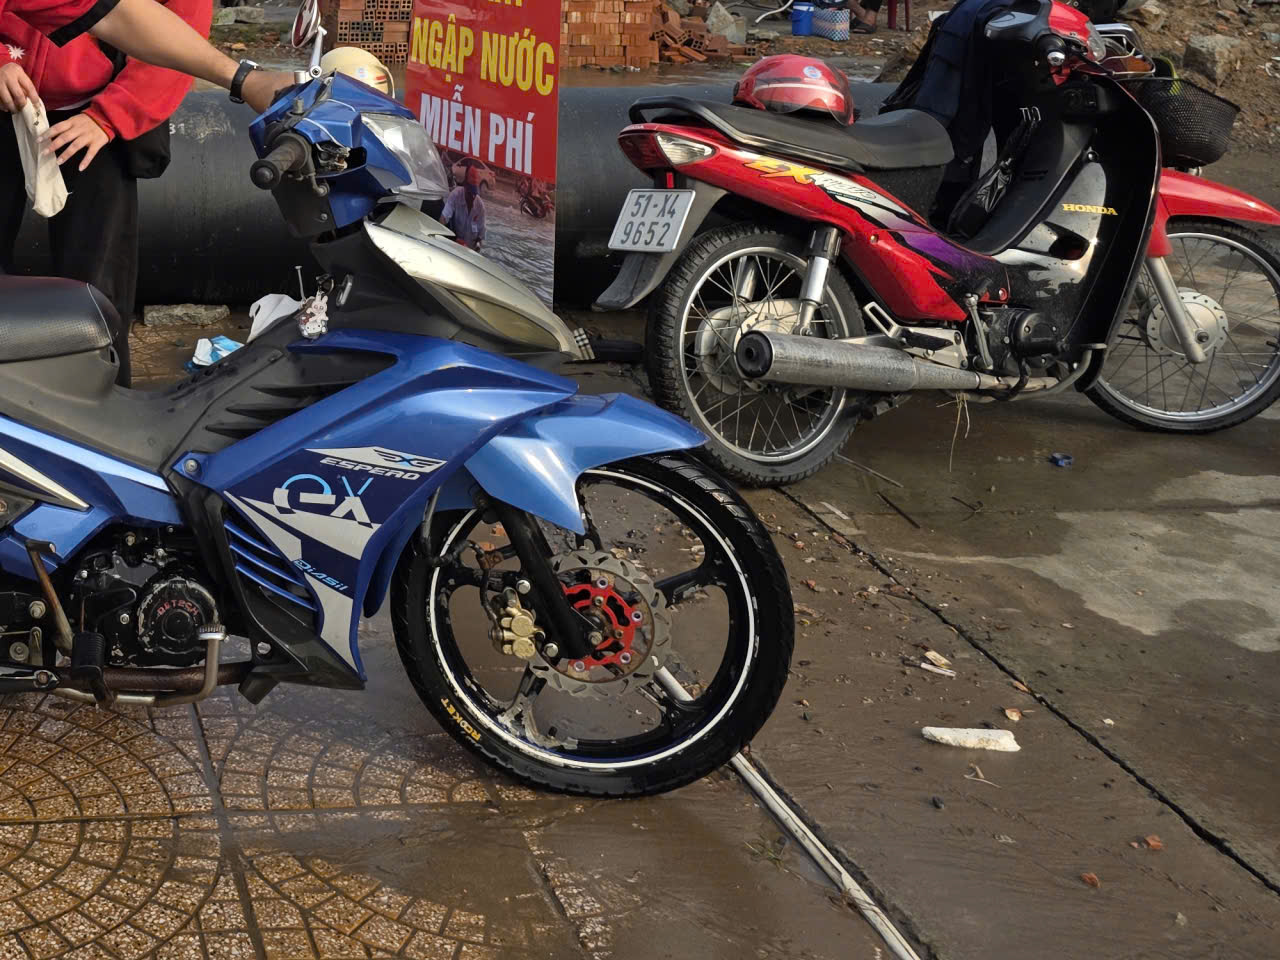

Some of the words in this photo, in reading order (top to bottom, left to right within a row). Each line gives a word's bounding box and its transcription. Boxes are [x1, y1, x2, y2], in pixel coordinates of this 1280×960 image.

[410, 13, 475, 82] NGẬP
[480, 26, 555, 96] NƯỚC
[421, 84, 482, 158] MIỄN
[488, 110, 534, 175] PHÍ
[631, 193, 678, 219] 51-X4
[1062, 203, 1118, 216] HONDA
[622, 220, 672, 248] 9652
[320, 457, 421, 480] ESPERO
